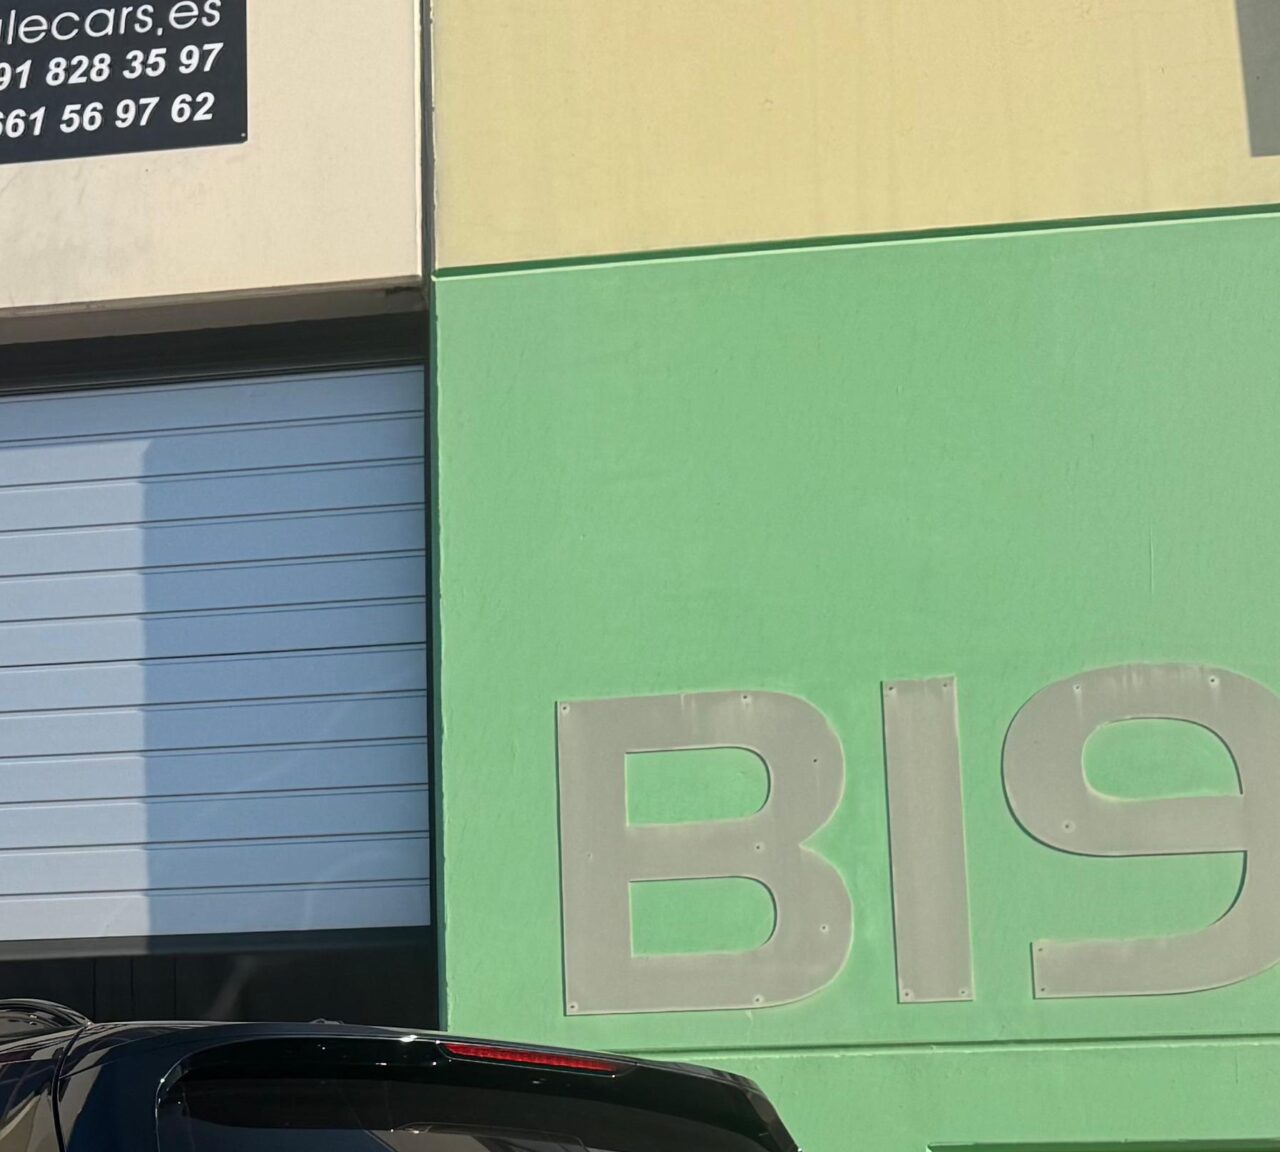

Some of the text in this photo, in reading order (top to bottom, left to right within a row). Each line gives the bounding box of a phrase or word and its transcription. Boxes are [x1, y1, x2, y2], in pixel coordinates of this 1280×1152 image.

[45, 53, 111, 87] 828
[122, 47, 166, 80] 35
[178, 42, 223, 75] 97
[59, 101, 103, 133] 56
[114, 96, 160, 129] 97
[170, 91, 215, 122] 62
